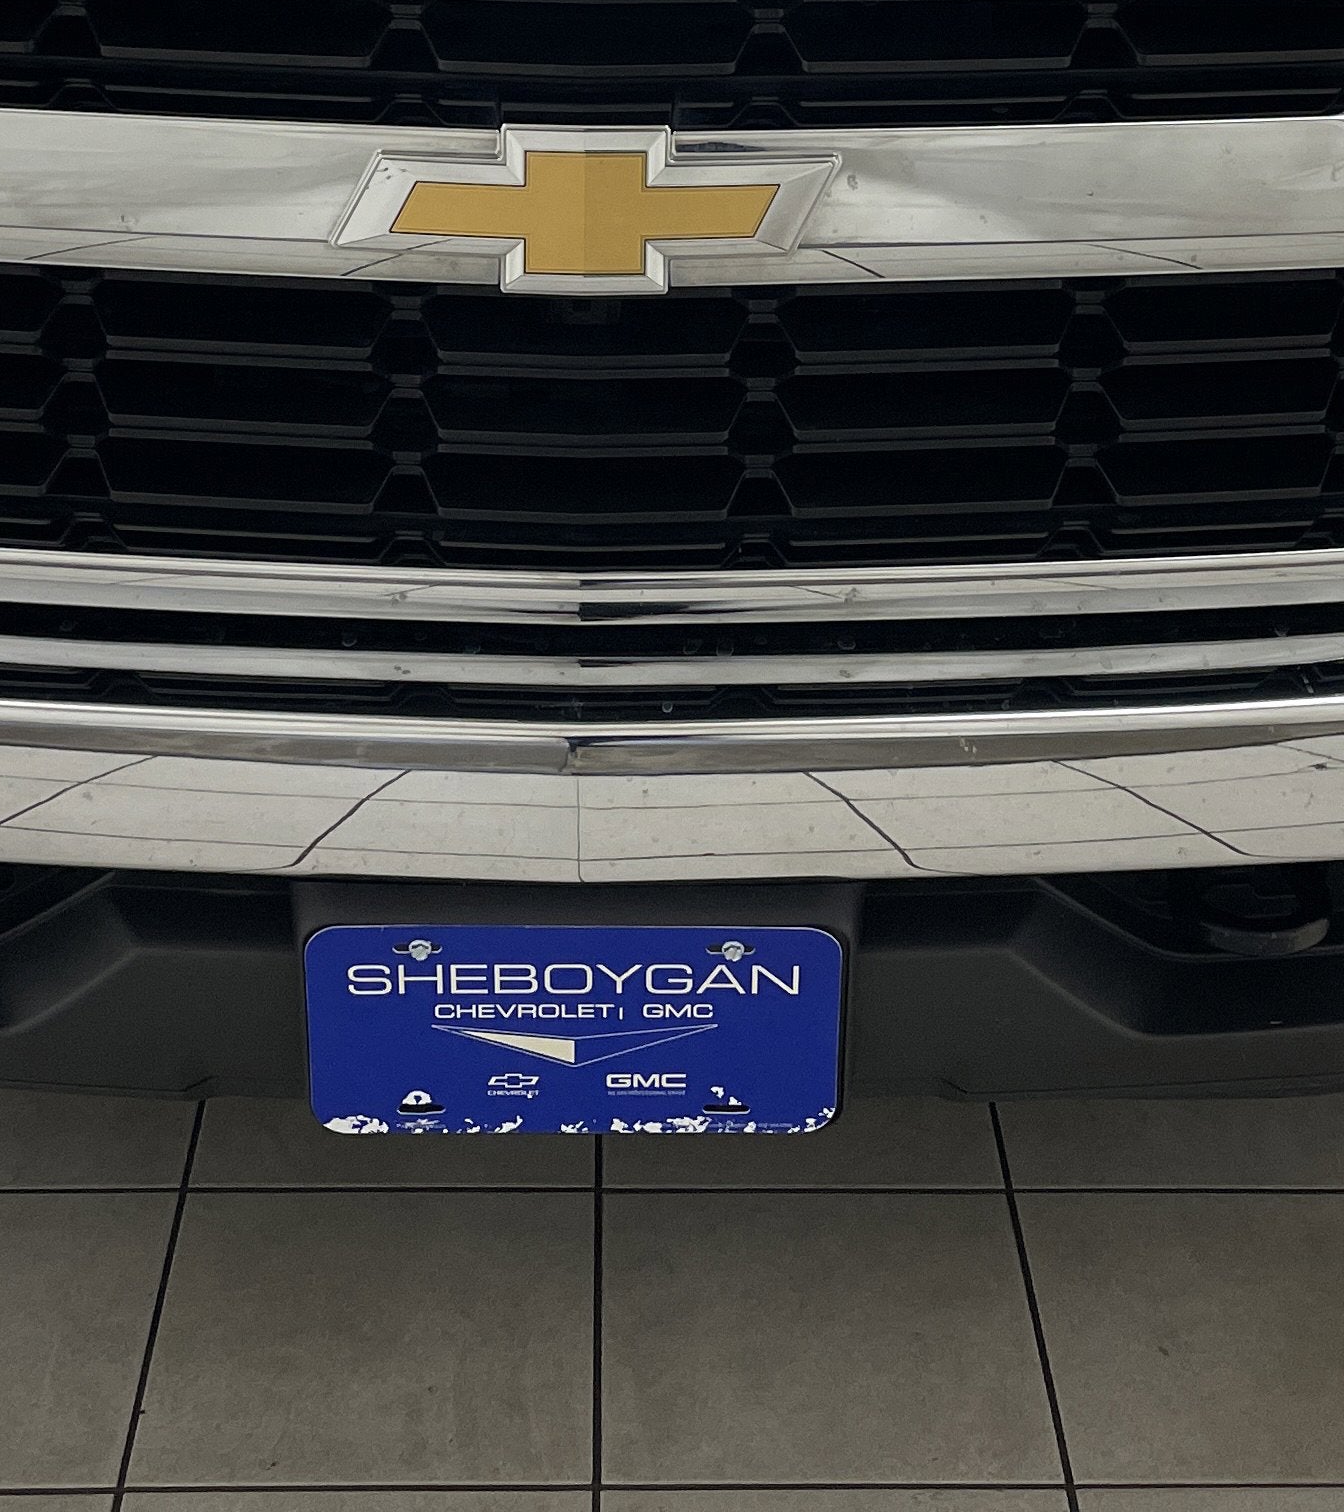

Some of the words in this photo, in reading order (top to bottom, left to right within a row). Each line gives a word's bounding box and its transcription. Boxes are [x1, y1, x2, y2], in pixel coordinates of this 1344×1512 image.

[347, 963, 800, 996] SHEBOYGAN
[434, 1003, 615, 1019] CHEVROLET
[642, 1003, 714, 1019] GMC
[606, 1073, 687, 1088] GMC
